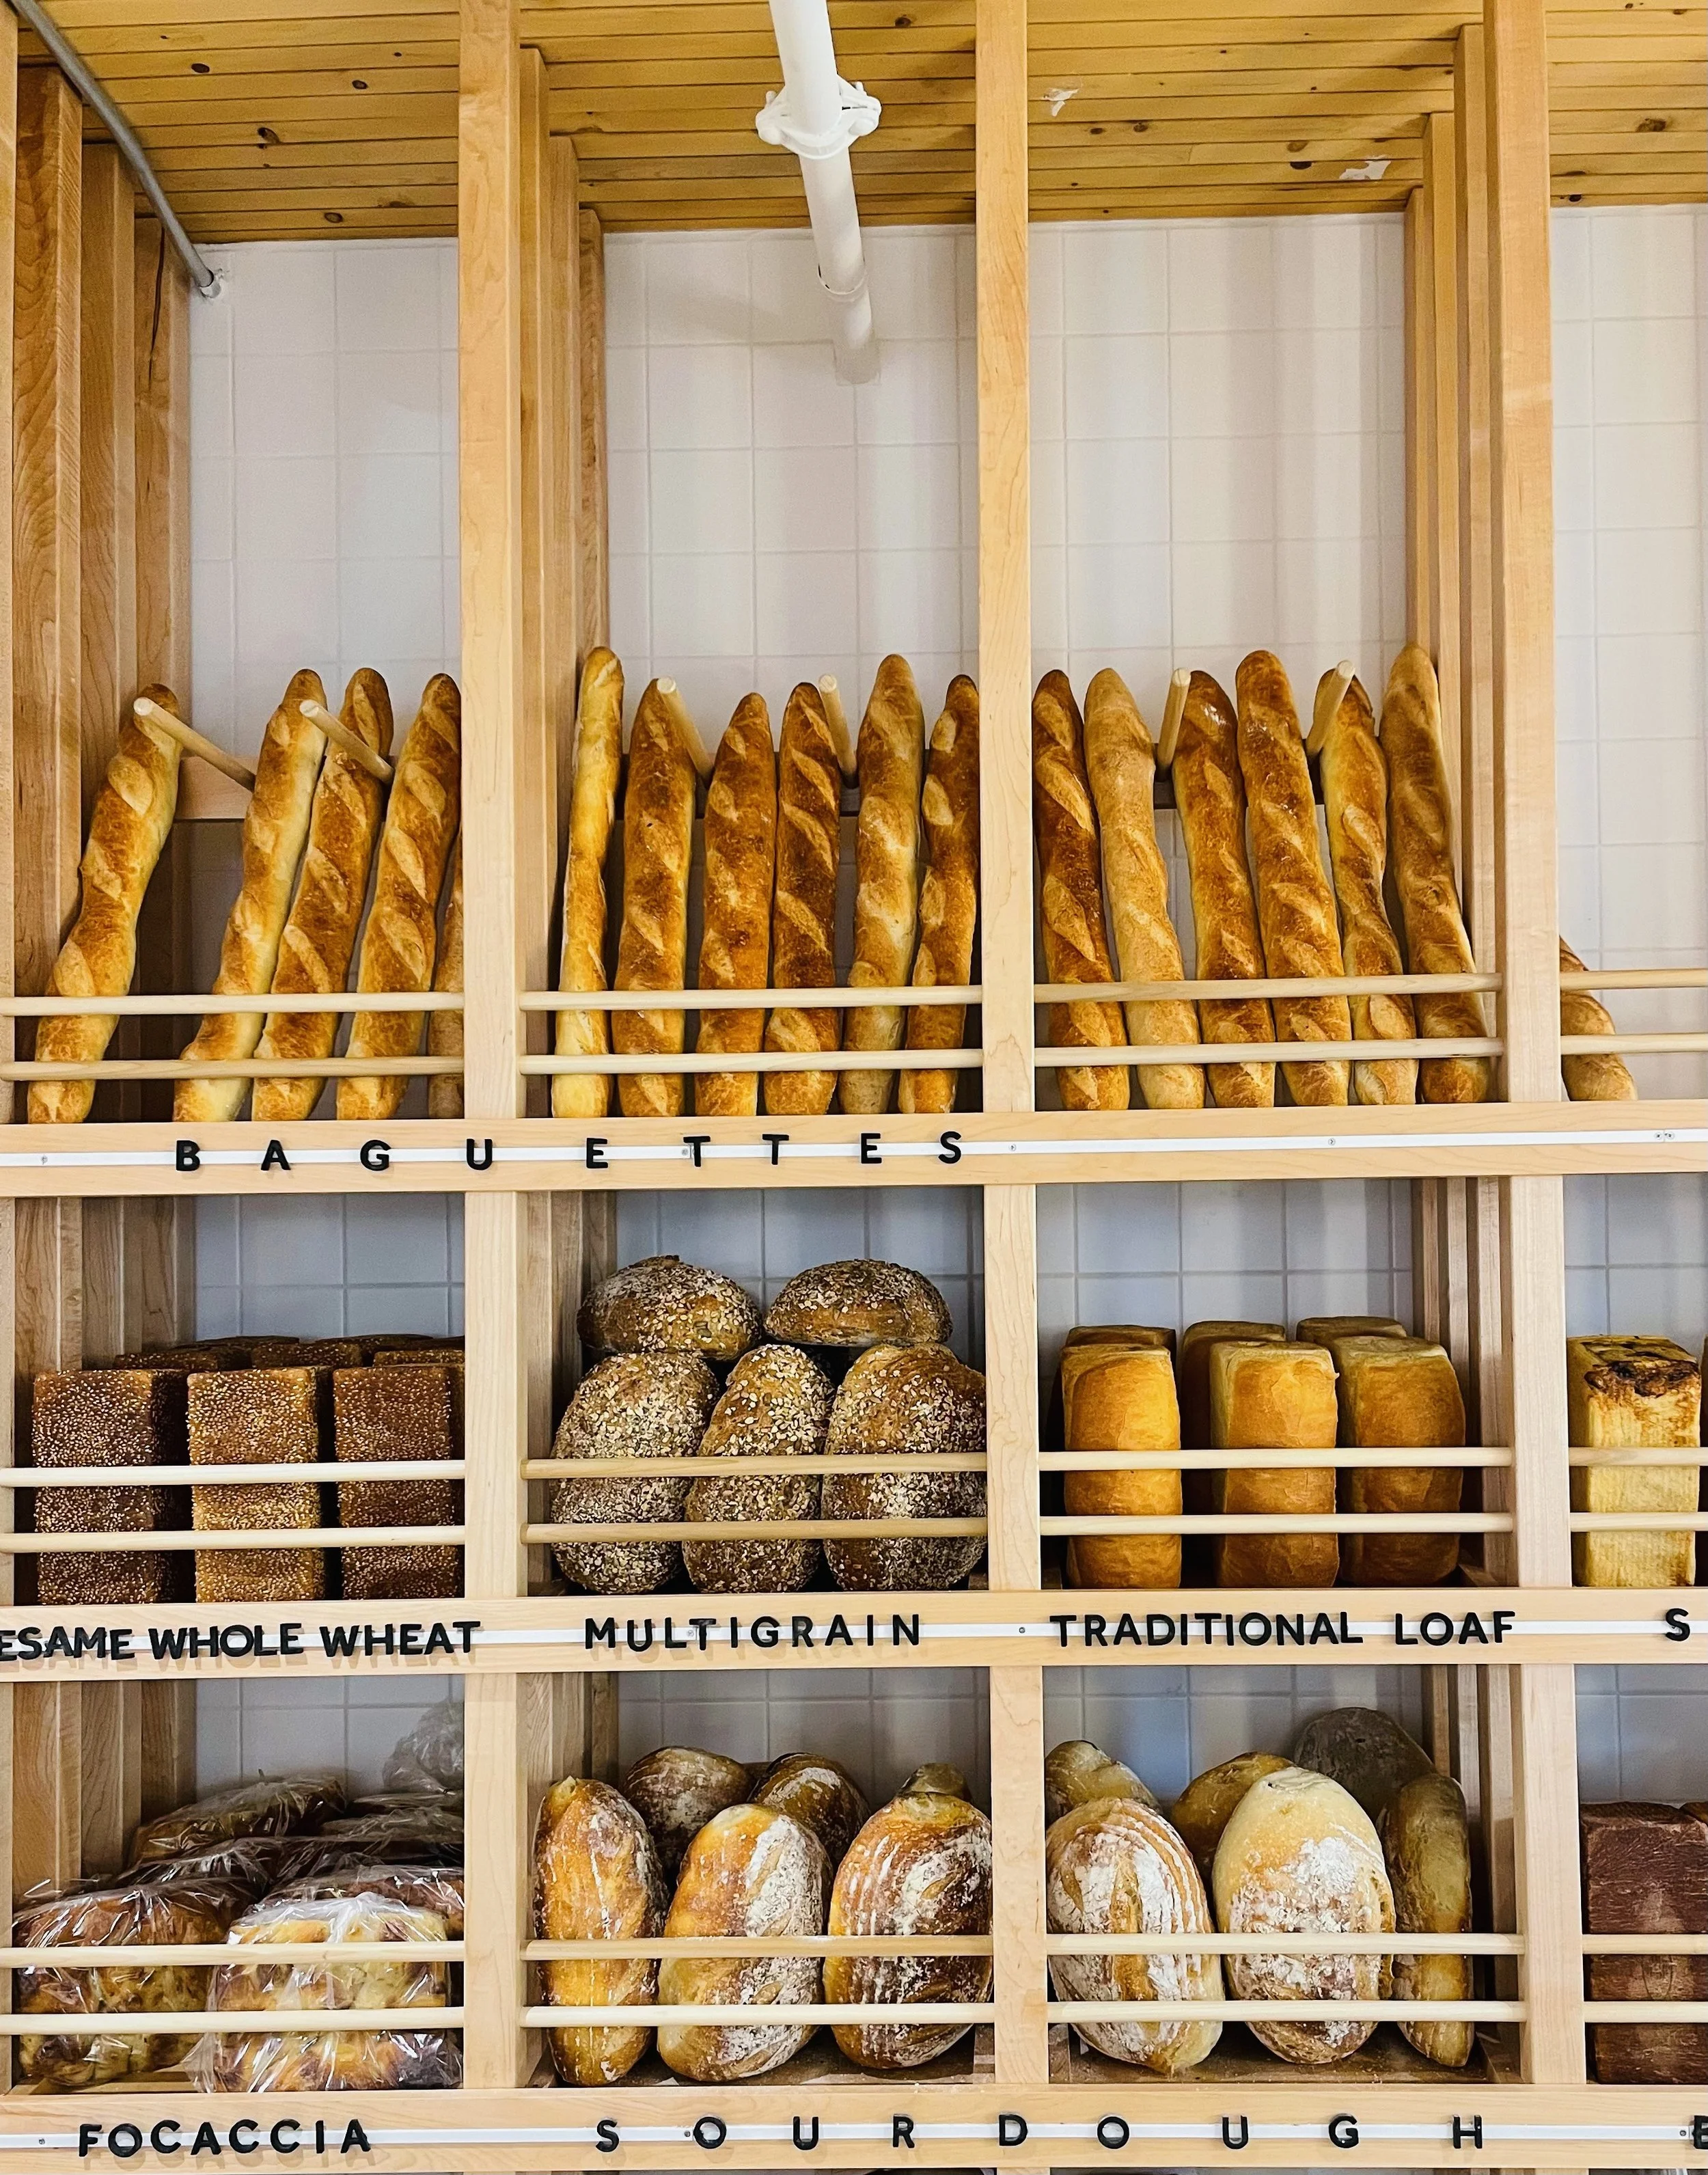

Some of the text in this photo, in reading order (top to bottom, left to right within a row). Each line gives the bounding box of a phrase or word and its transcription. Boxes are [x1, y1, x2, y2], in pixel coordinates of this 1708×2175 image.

[176, 1132, 961, 1173] BAGUETTES
[148, 1622, 304, 1660] WHOLE
[320, 1621, 481, 1658] WHEAT
[585, 1614, 920, 1650] MULTIGRAIN
[1049, 1611, 1515, 1647] TRADITIONAL LOAF
[1665, 1608, 1691, 1642] S
[79, 2119, 372, 2157] FOCACCIA
[595, 2114, 1483, 2152] SOURDOUGH
